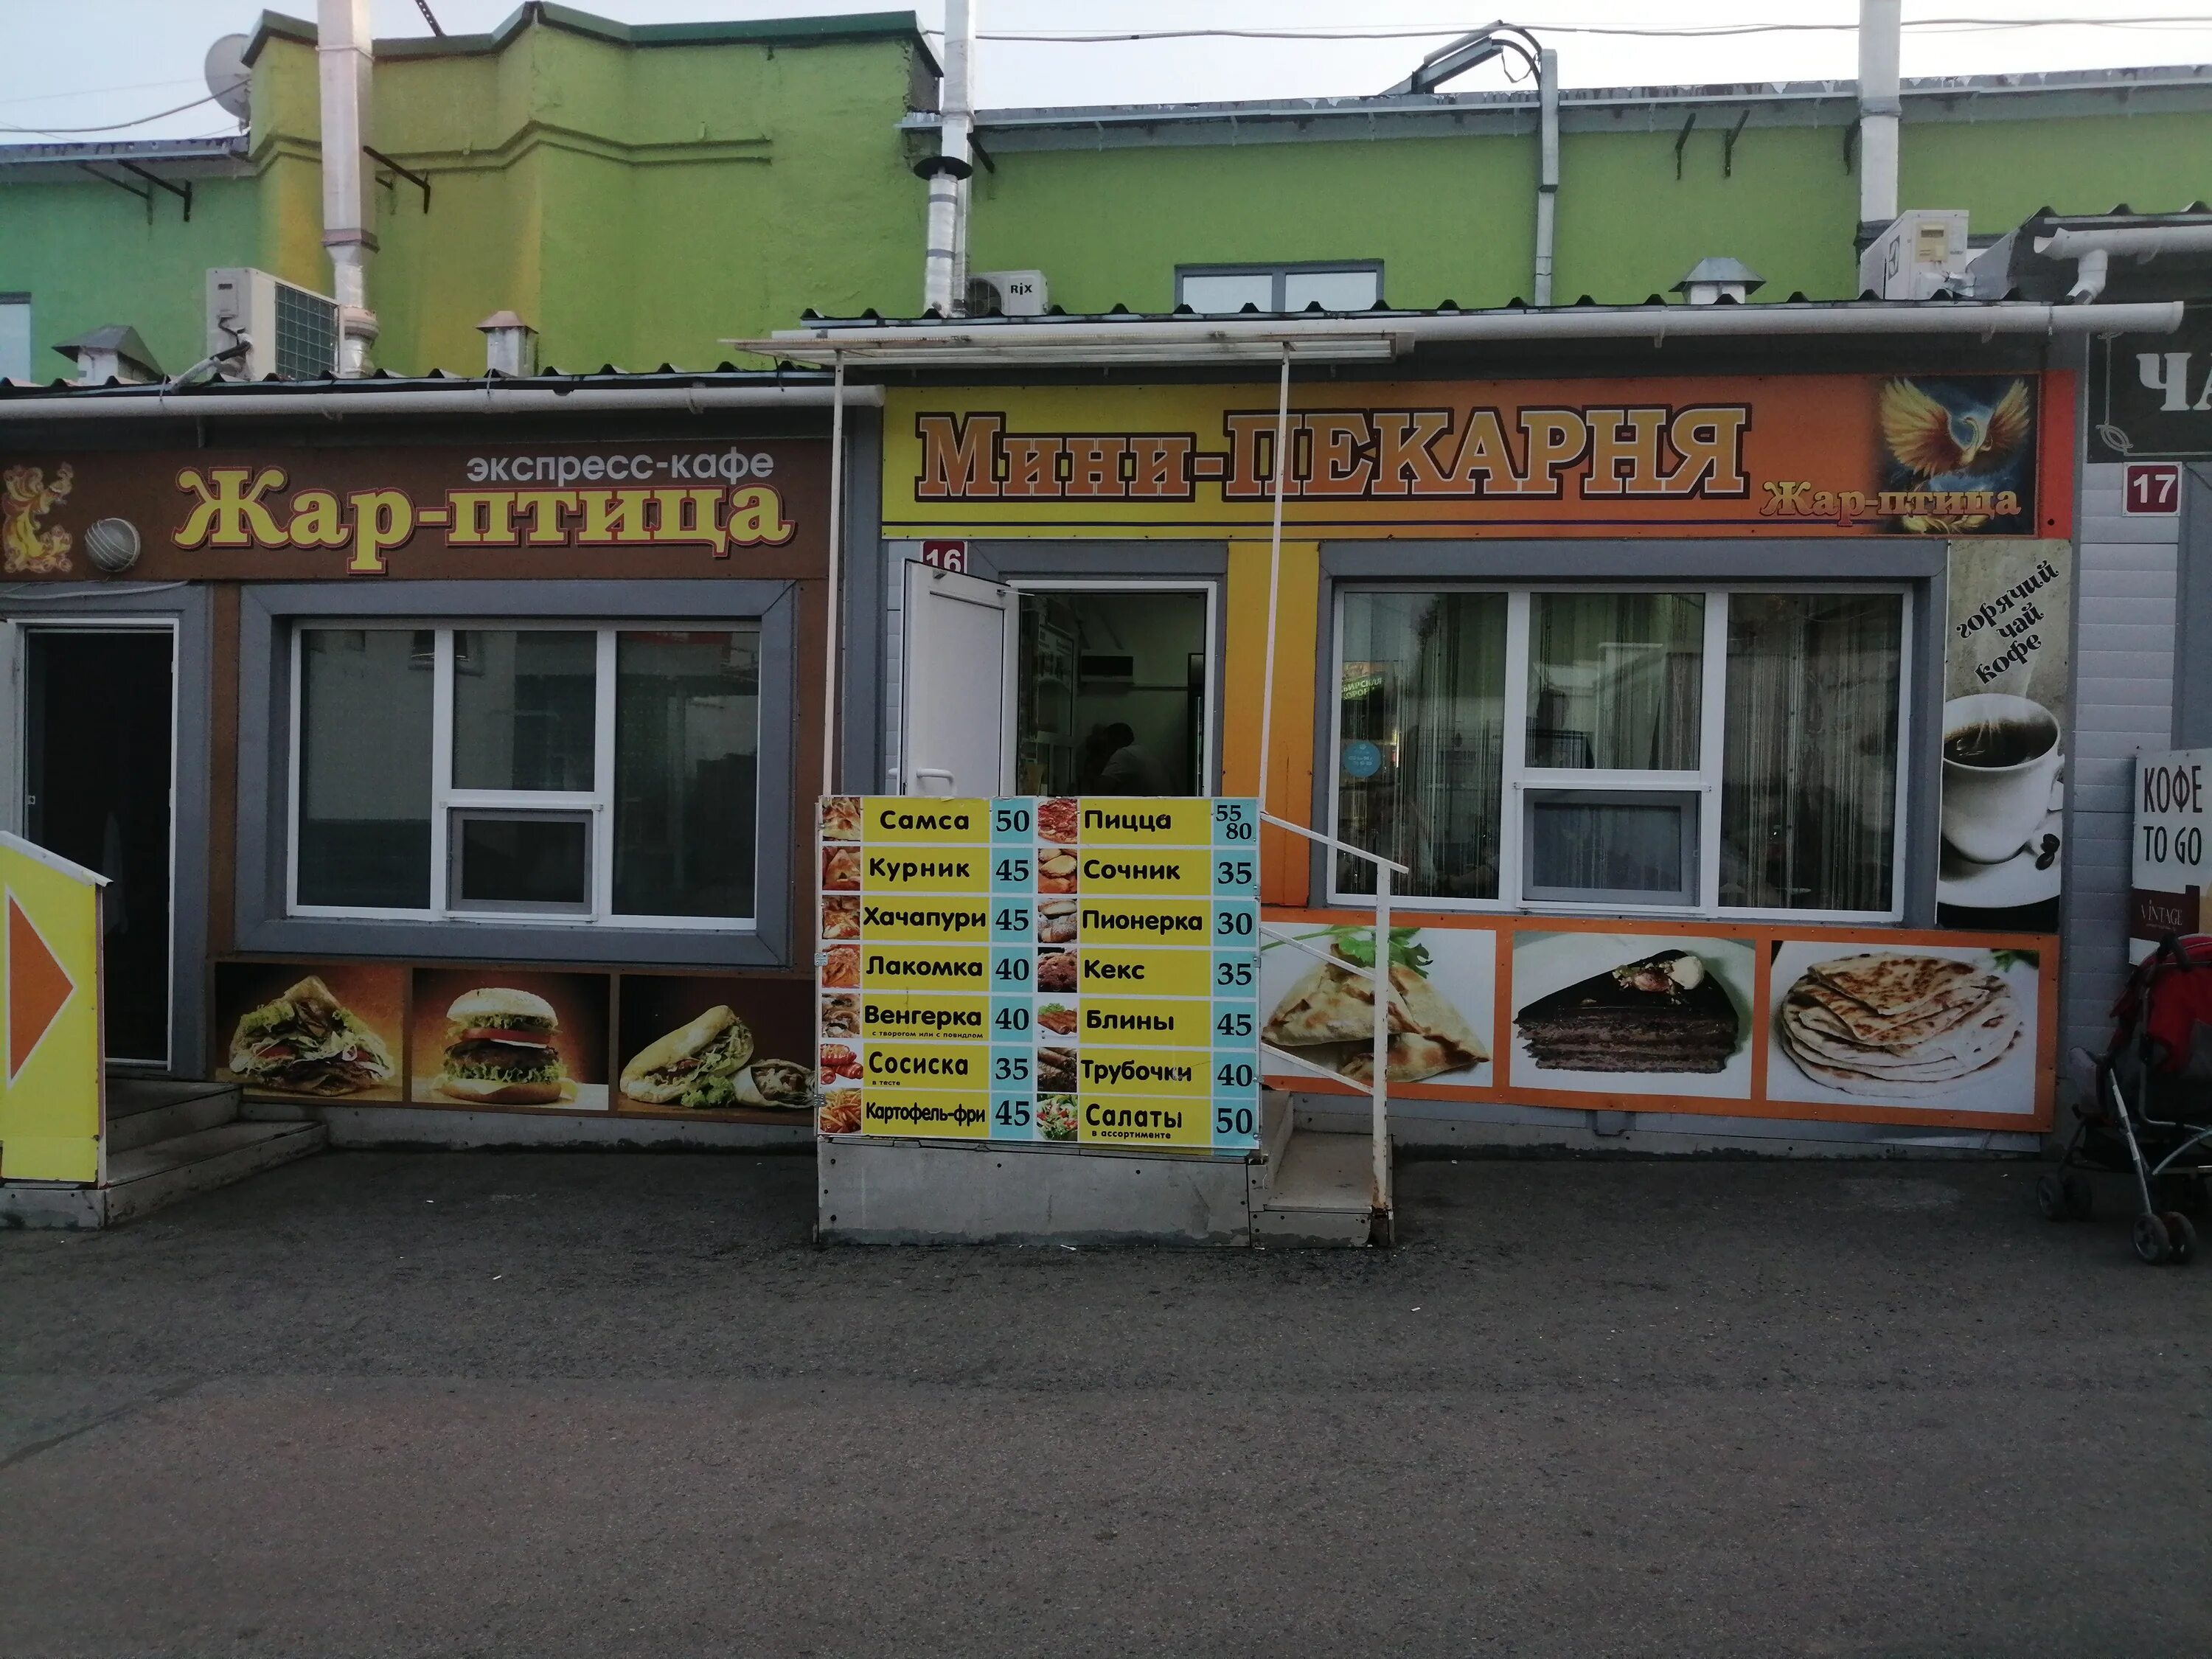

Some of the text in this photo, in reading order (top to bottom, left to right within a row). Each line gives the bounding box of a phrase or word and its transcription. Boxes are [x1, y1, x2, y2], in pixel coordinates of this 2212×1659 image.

[466, 447, 773, 486] экспресс-кафе
[2133, 474, 2176, 504] 17
[1760, 481, 2021, 526] Жар-птица
[170, 465, 796, 574] Жар-птица
[926, 549, 961, 572] 16
[1955, 560, 2059, 639] горячий
[1996, 602, 2045, 639] чай
[1975, 634, 2042, 684] кофе
[2143, 765, 2203, 813] КОФЕ
[880, 810, 1029, 832] Самса 50
[1085, 805, 1241, 832] Пицца 55
[1226, 823, 1251, 839] 80
[2143, 826, 2202, 866] TO GO
[870, 858, 1029, 882] Курник 45
[1084, 860, 1251, 884] Сочник 35
[864, 907, 1029, 931] Хачапури 45
[1083, 910, 1252, 935] Пионерка 30
[866, 956, 1029, 981] Лакомка 40
[1085, 960, 1251, 985] Кекс 35
[865, 1006, 1029, 1030] Венгерка 40
[1087, 1010, 1251, 1036] Блины 45
[869, 1051, 1028, 1080] Сосиска 35
[1081, 1060, 1252, 1086] Трубочки 40
[866, 1100, 1029, 1127] Картофель-фри 45
[1086, 1104, 1252, 1134] Салаты 50
[1101, 1130, 1171, 1139] ассортименте
